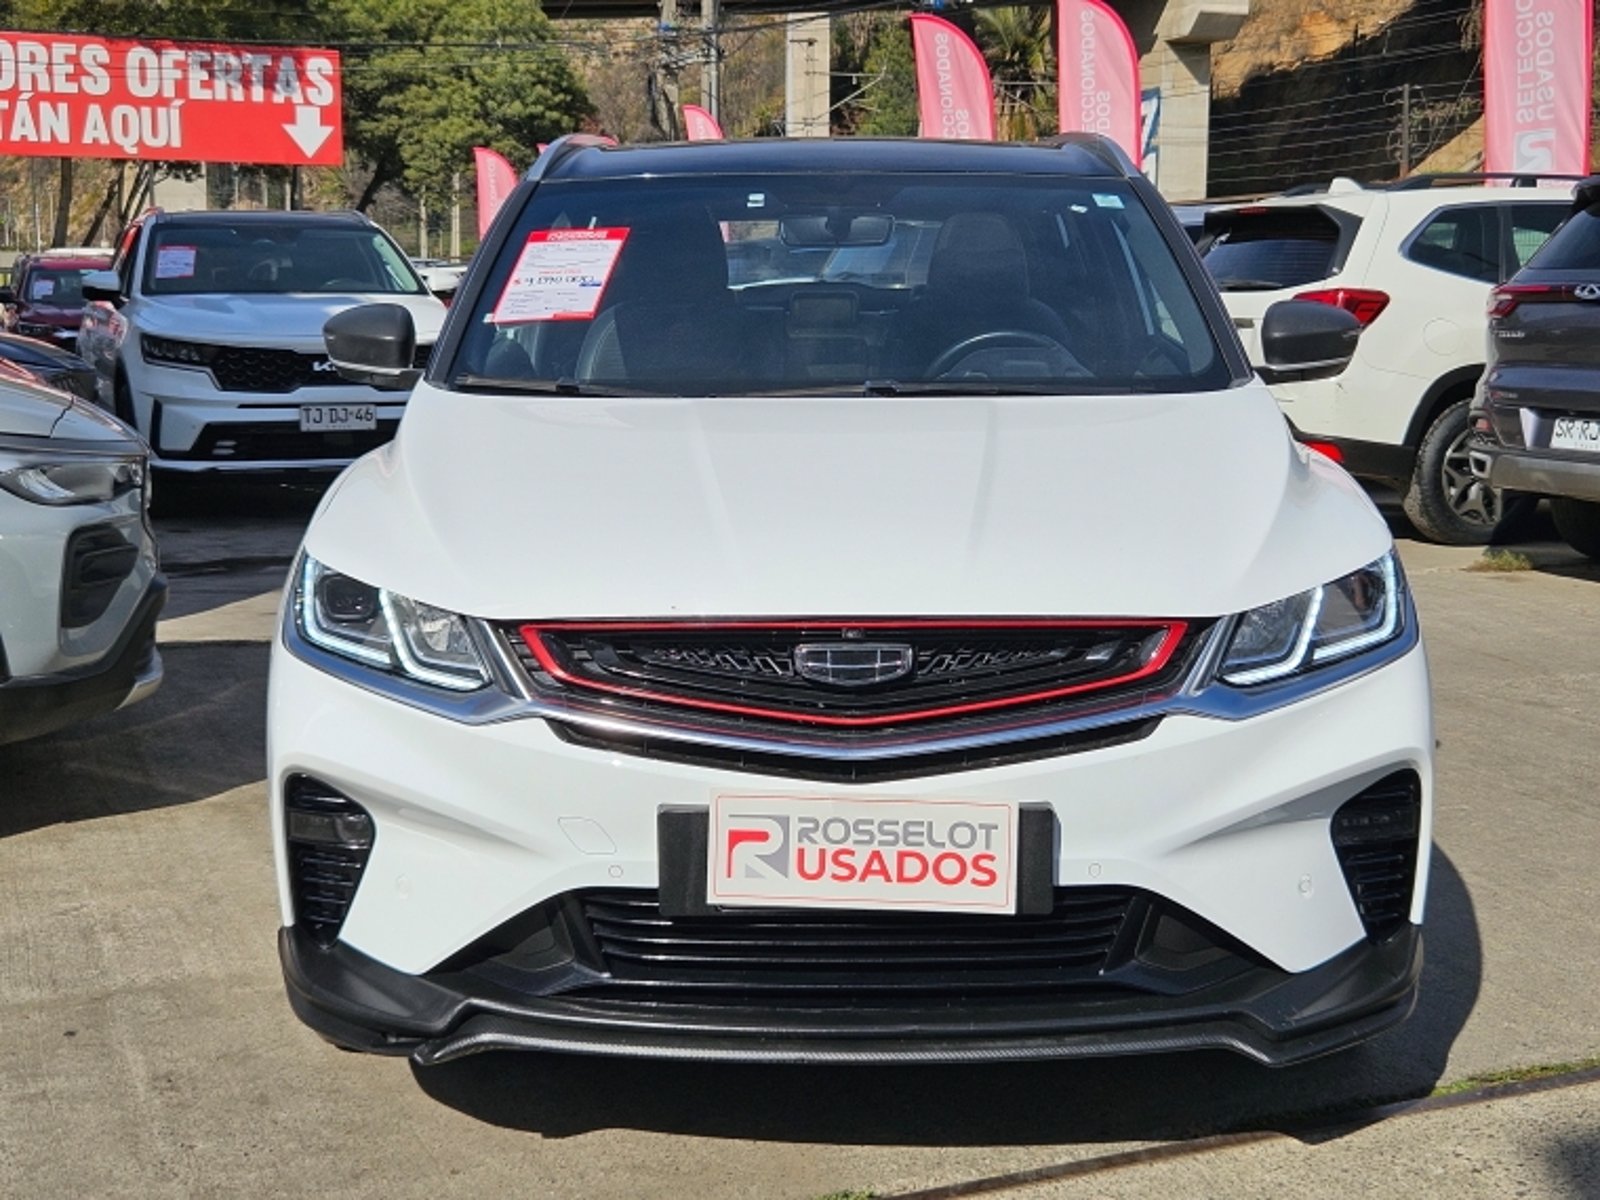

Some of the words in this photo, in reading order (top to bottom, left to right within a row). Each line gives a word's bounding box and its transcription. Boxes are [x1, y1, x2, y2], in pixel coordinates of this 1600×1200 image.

[125, 46, 335, 106] OFERTAS
[82, 99, 186, 154] AQUÍ
[797, 815, 999, 851] ROSSELOT
[796, 847, 999, 888] USADOS
